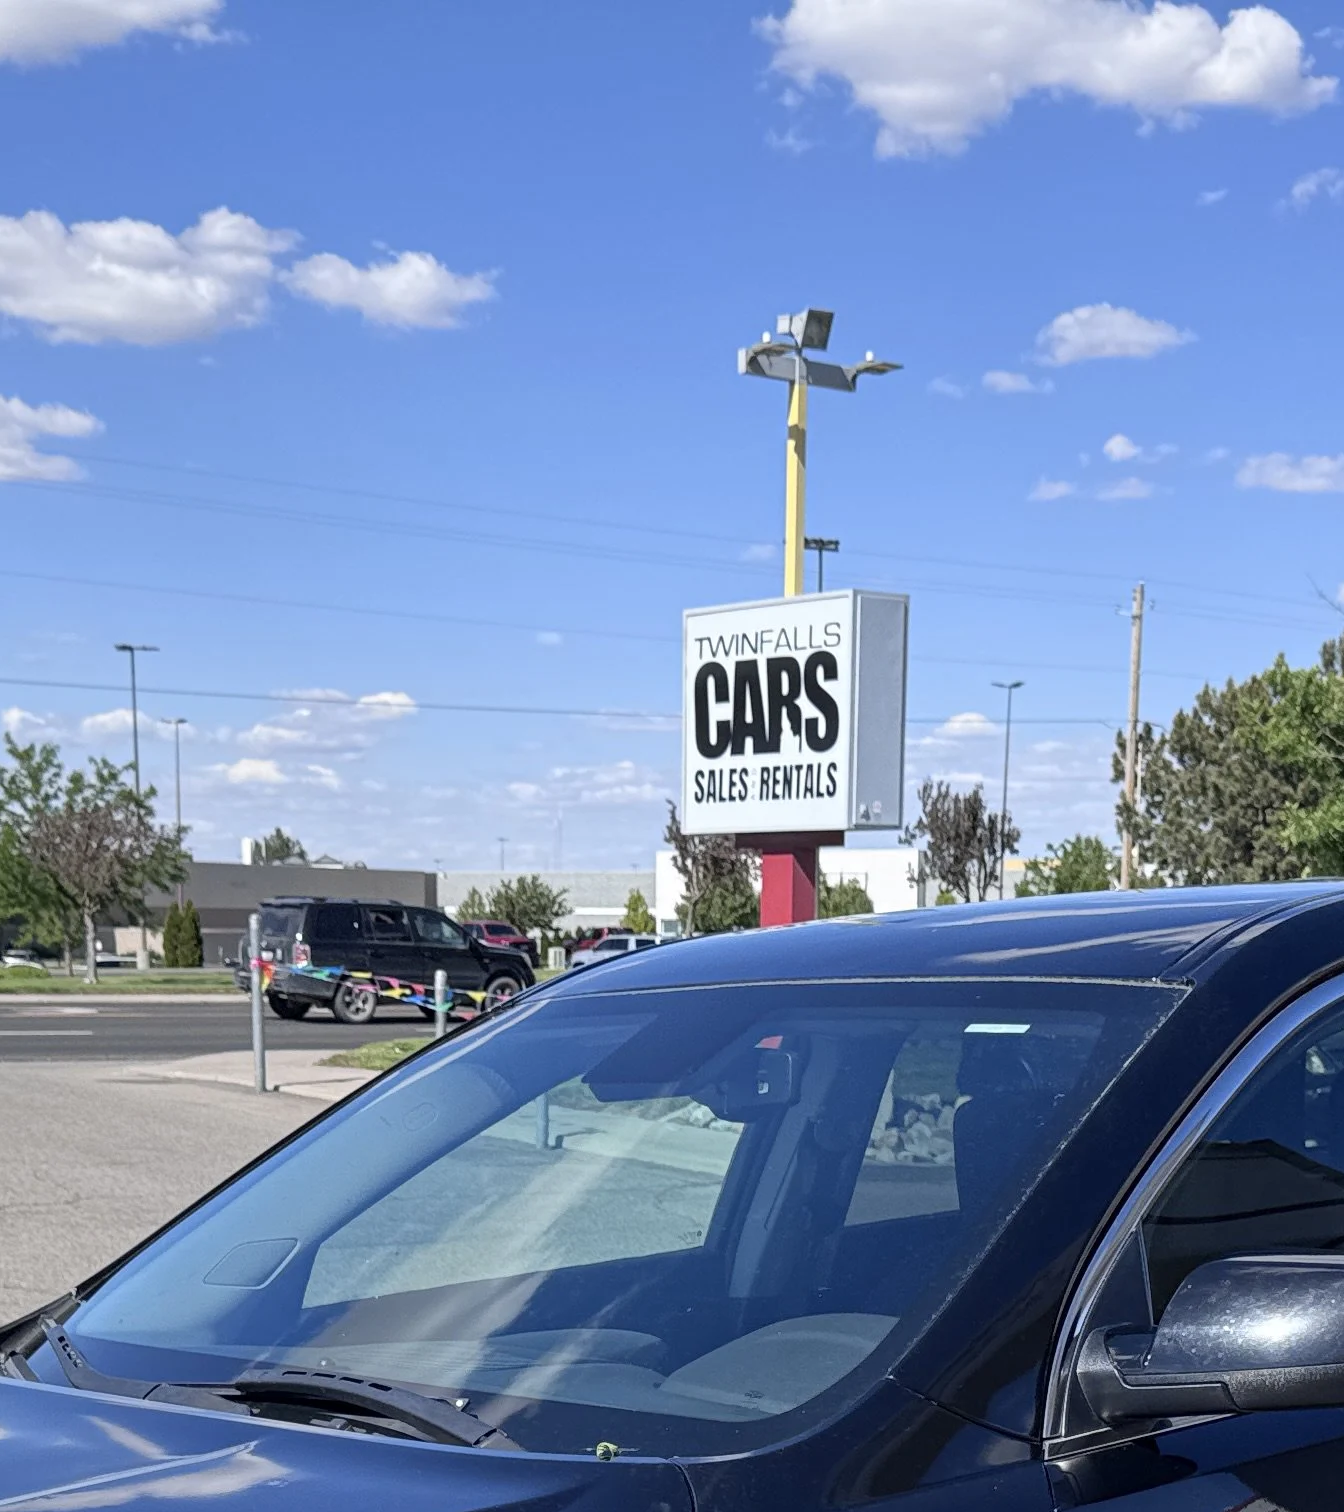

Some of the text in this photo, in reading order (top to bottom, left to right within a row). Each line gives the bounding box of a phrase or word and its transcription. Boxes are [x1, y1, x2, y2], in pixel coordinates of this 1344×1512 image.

[694, 622, 841, 660] TWINFALLS
[694, 650, 839, 760] CARS
[694, 767, 749, 804] SALES
[759, 762, 837, 801] RENTALS
